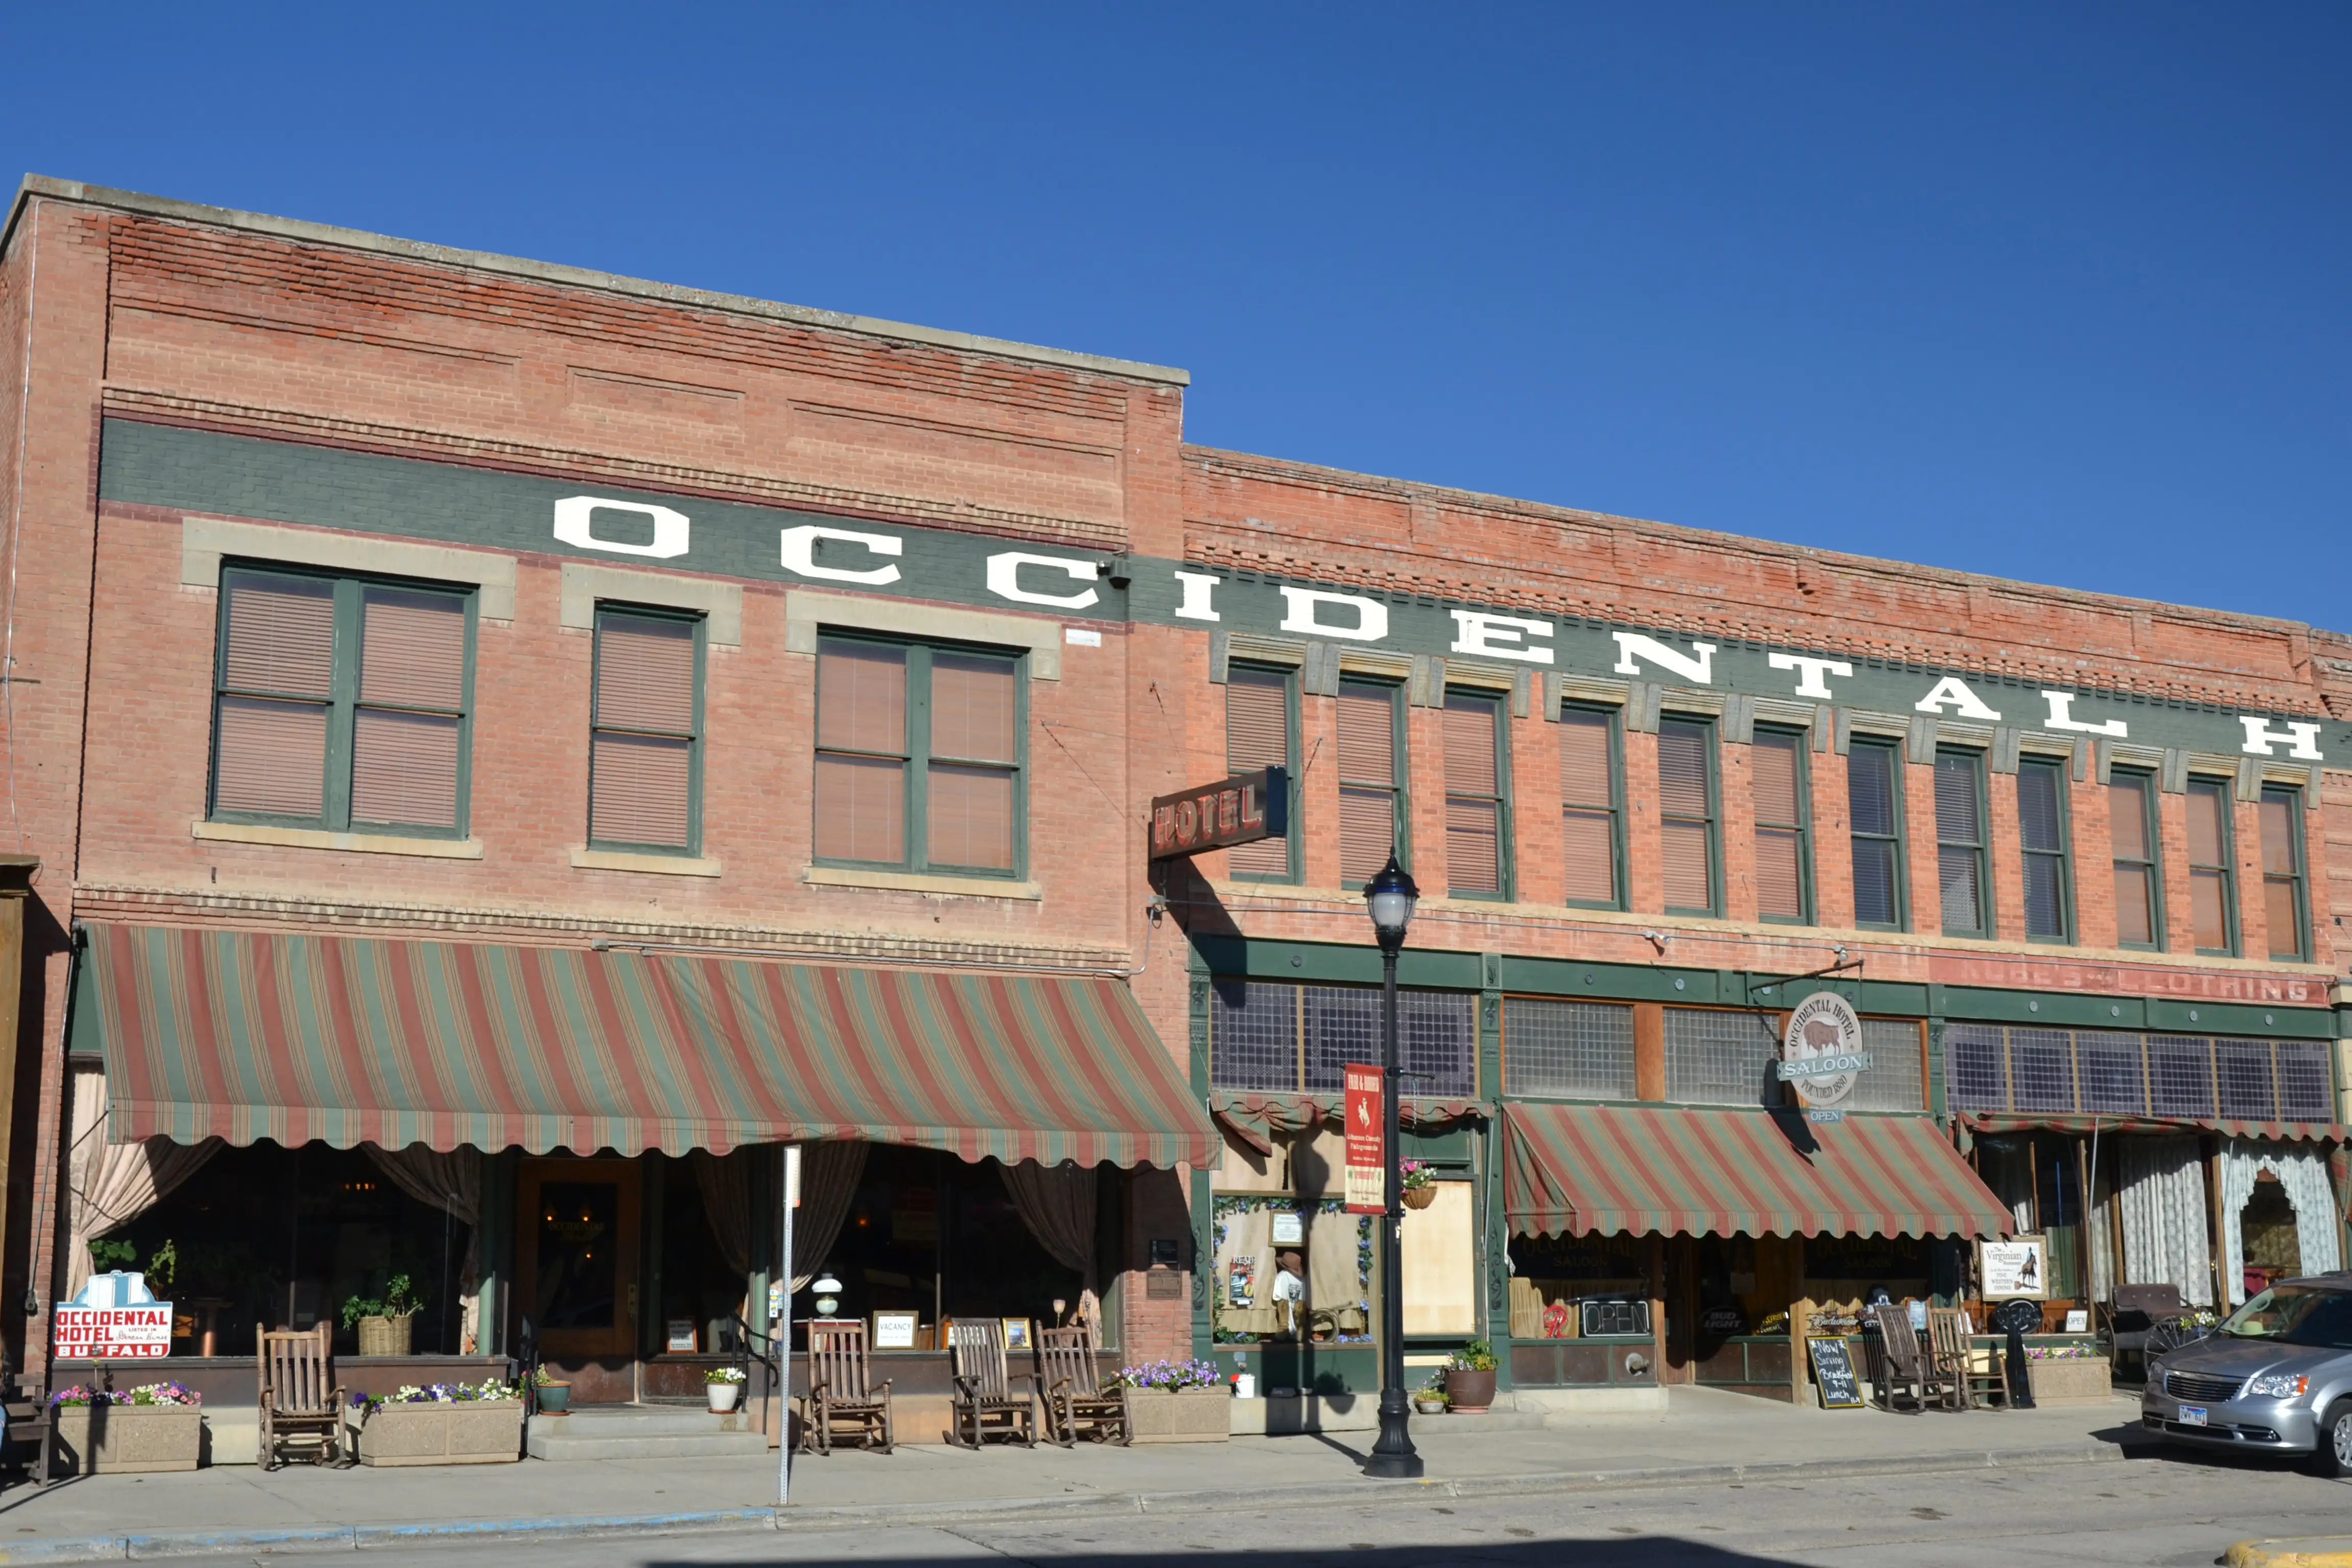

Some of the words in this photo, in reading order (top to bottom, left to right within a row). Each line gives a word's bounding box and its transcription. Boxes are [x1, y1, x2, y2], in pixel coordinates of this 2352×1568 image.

[553, 495, 2127, 737] OCCIDENTAL
[1155, 784, 1263, 850] HOTEL
[1789, 999, 1831, 1048] OCCIDENTAL
[1832, 1003, 1855, 1040] HOTEL
[1784, 1055, 1863, 1076] SALOON
[1348, 1073, 1359, 1090] FAIR
[1801, 1079, 1833, 1099] FOUNDED
[1833, 1074, 1848, 1094] 1880
[1811, 1111, 1840, 1121] OPEN
[1347, 1133, 1365, 1141] Johnson
[1365, 1135, 1381, 1144] County
[1350, 1142, 1379, 1152] Fairgrounds
[1553, 1255, 1608, 1267] SALOON
[1986, 1250, 2022, 1263] Virginian
[57, 1311, 168, 1326] OCCIDENTAL
[1586, 1305, 1648, 1334] OPEN
[1710, 1311, 1737, 1319] BUD
[2068, 1316, 2086, 1325] OPEN
[879, 1322, 912, 1331] VACANCY
[1703, 1320, 1742, 1329] LIGHT
[56, 1327, 114, 1342] HOTEL
[1816, 1340, 1839, 1354] Now
[1815, 1353, 1845, 1369] Serving
[1820, 1369, 1854, 1380] Breakfast
[1825, 1388, 1850, 1400] Lunch
